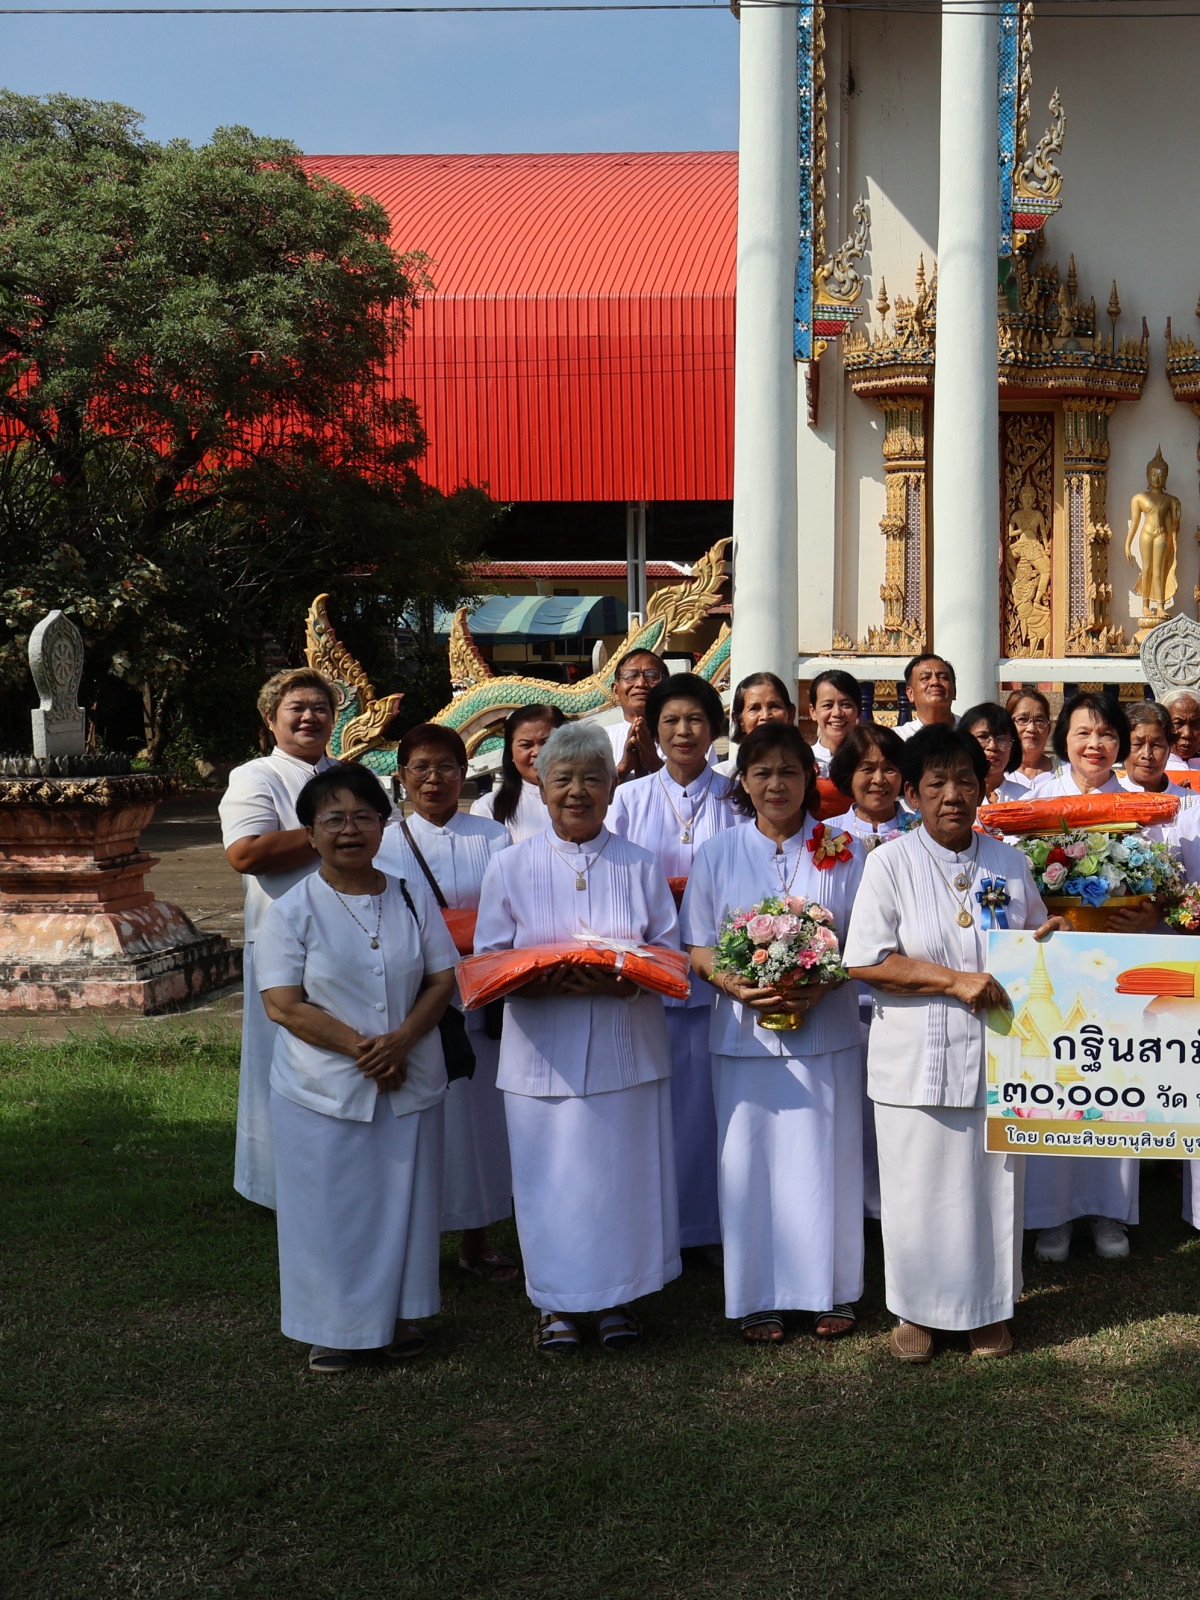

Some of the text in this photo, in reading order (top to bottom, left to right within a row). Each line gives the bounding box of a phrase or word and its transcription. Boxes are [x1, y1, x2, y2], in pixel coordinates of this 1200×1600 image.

[1003, 1082, 1146, 1110] ๓๐,๐๐๐
[1156, 1084, 1188, 1109] วัด
[1007, 1126, 1037, 1143] โดย
[1045, 1131, 1175, 1152] คณะศิษยานุศิษย์
